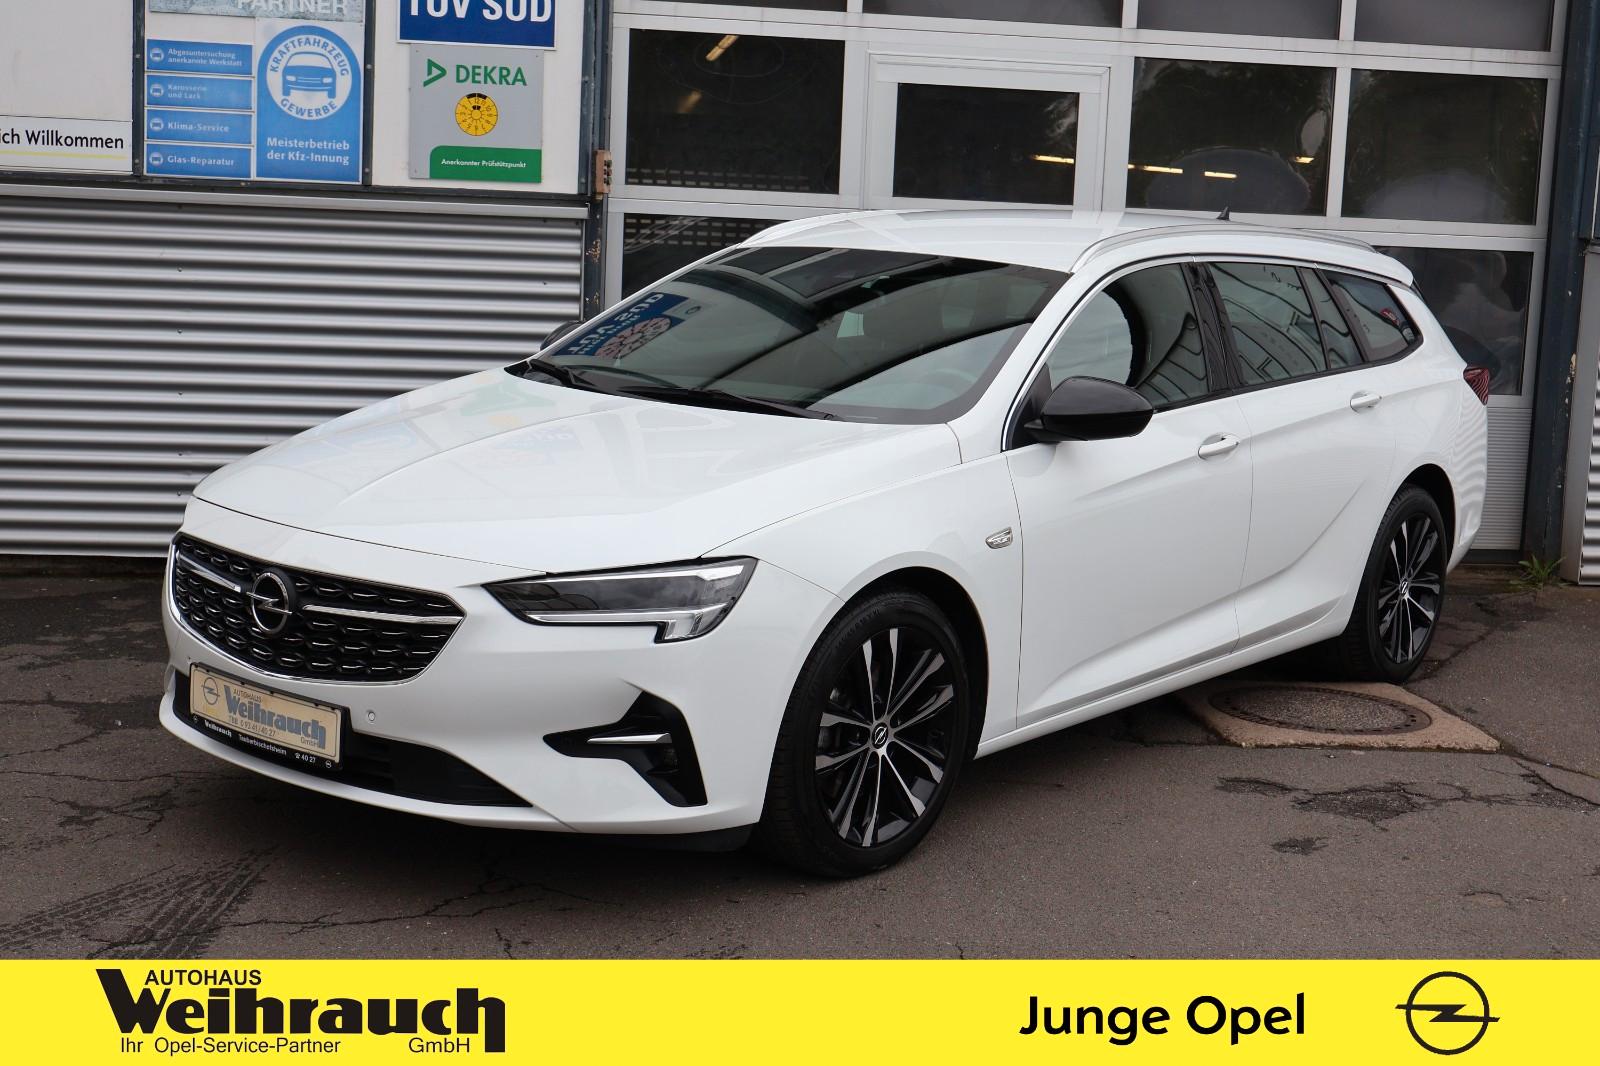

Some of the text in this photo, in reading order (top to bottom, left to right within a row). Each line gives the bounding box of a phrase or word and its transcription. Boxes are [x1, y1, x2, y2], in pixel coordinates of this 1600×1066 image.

[209, 58, 242, 66] Werkstatt
[269, 37, 349, 76] KRAFTFAHRZEUG
[456, 64, 527, 86] DEKRA
[280, 98, 337, 118] GEWERBE
[168, 121, 229, 132] Klima-Service
[25, 129, 124, 149] Willkommen
[266, 137, 350, 150] Meisterbetrieb
[167, 155, 234, 166] Glas-Reparatur
[266, 150, 349, 166] der Kfz-Innung
[441, 158, 480, 167] Anerkannter
[223, 684, 327, 750] Weihrauch
[204, 719, 232, 738] Weihrauch
